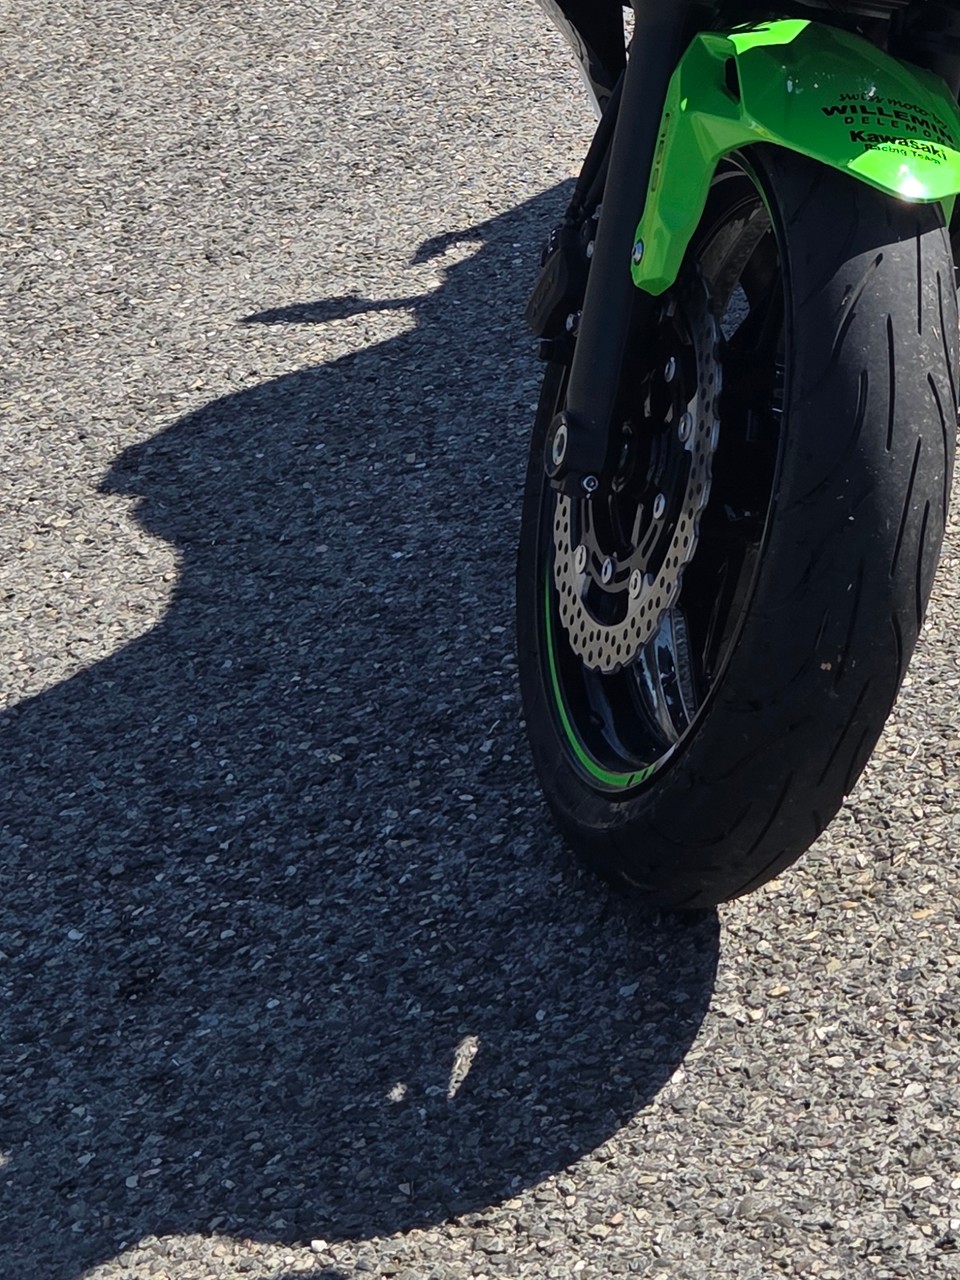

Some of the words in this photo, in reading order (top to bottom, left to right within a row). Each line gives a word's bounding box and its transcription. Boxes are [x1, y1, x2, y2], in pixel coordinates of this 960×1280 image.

[821, 104, 954, 143] WILLEMIN
[850, 130, 948, 161] Kawasaki
[865, 143, 908, 156] Racing
[911, 151, 941, 165] Team
